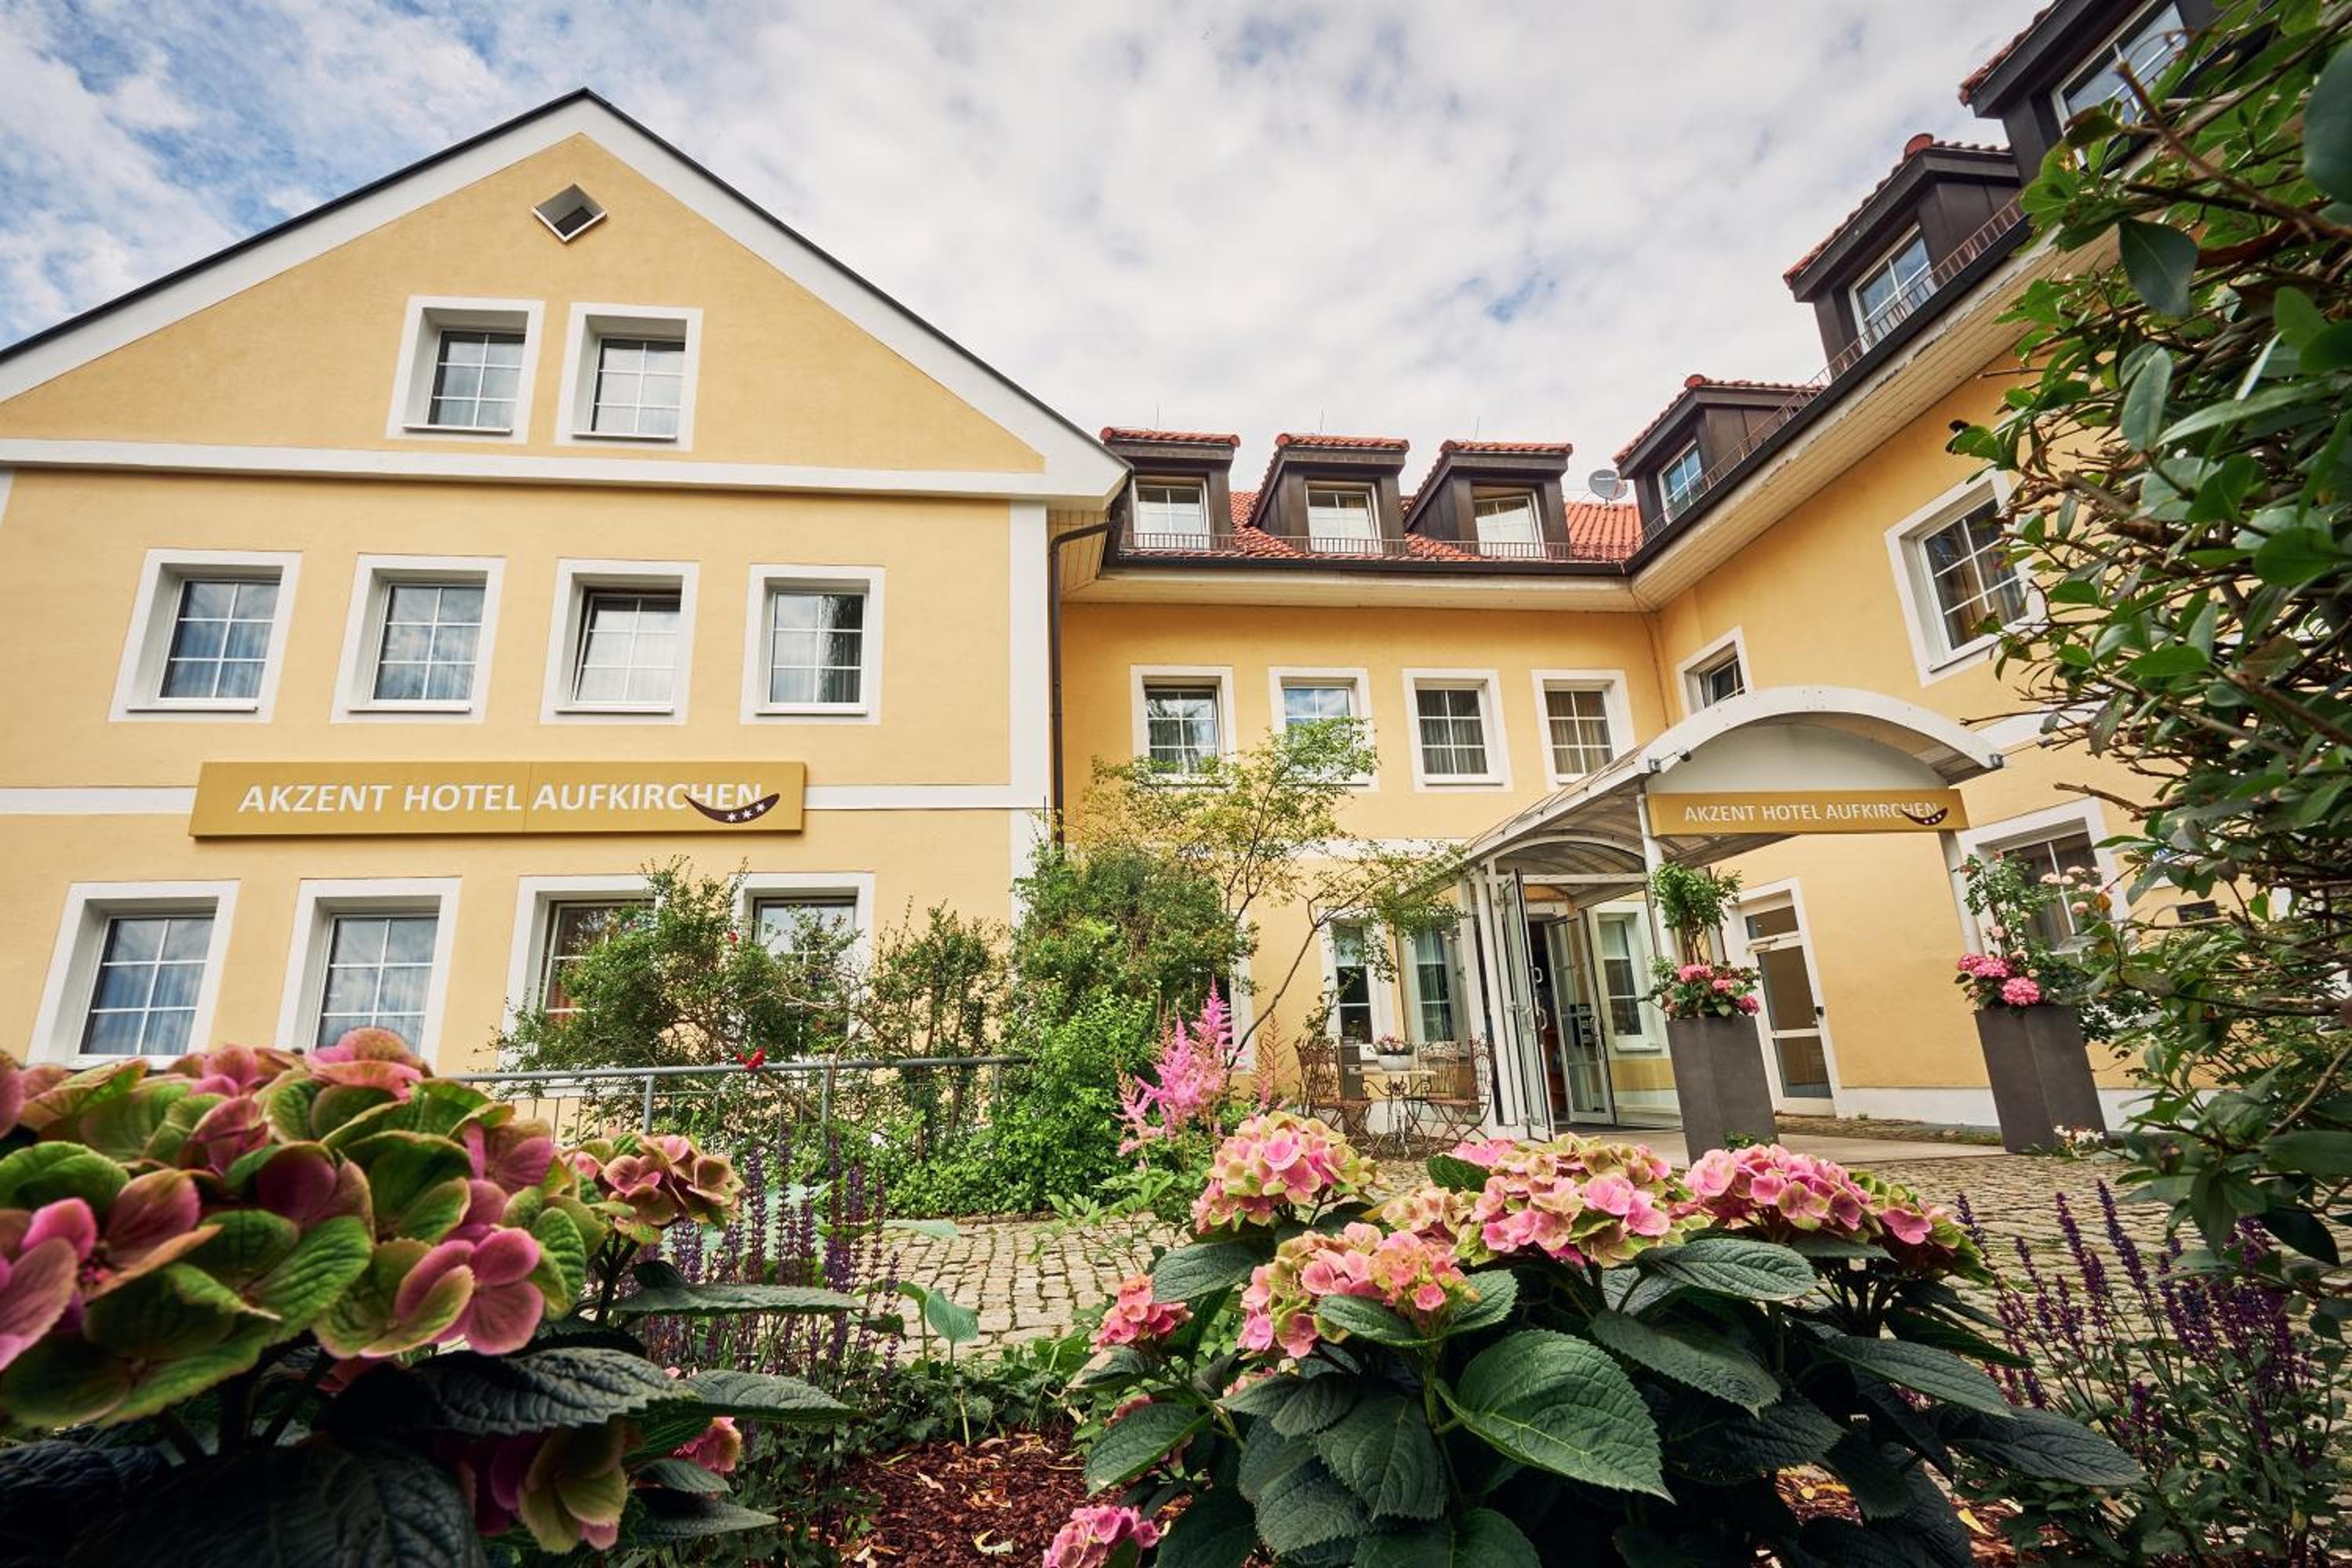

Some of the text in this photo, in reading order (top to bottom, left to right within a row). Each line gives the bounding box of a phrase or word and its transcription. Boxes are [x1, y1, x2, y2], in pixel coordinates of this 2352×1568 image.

[238, 783, 763, 813] AKZENT HOTEL AUFKIRCHEN
[1685, 805, 1755, 822] AKZENT
[1762, 804, 1821, 821] HOTEL
